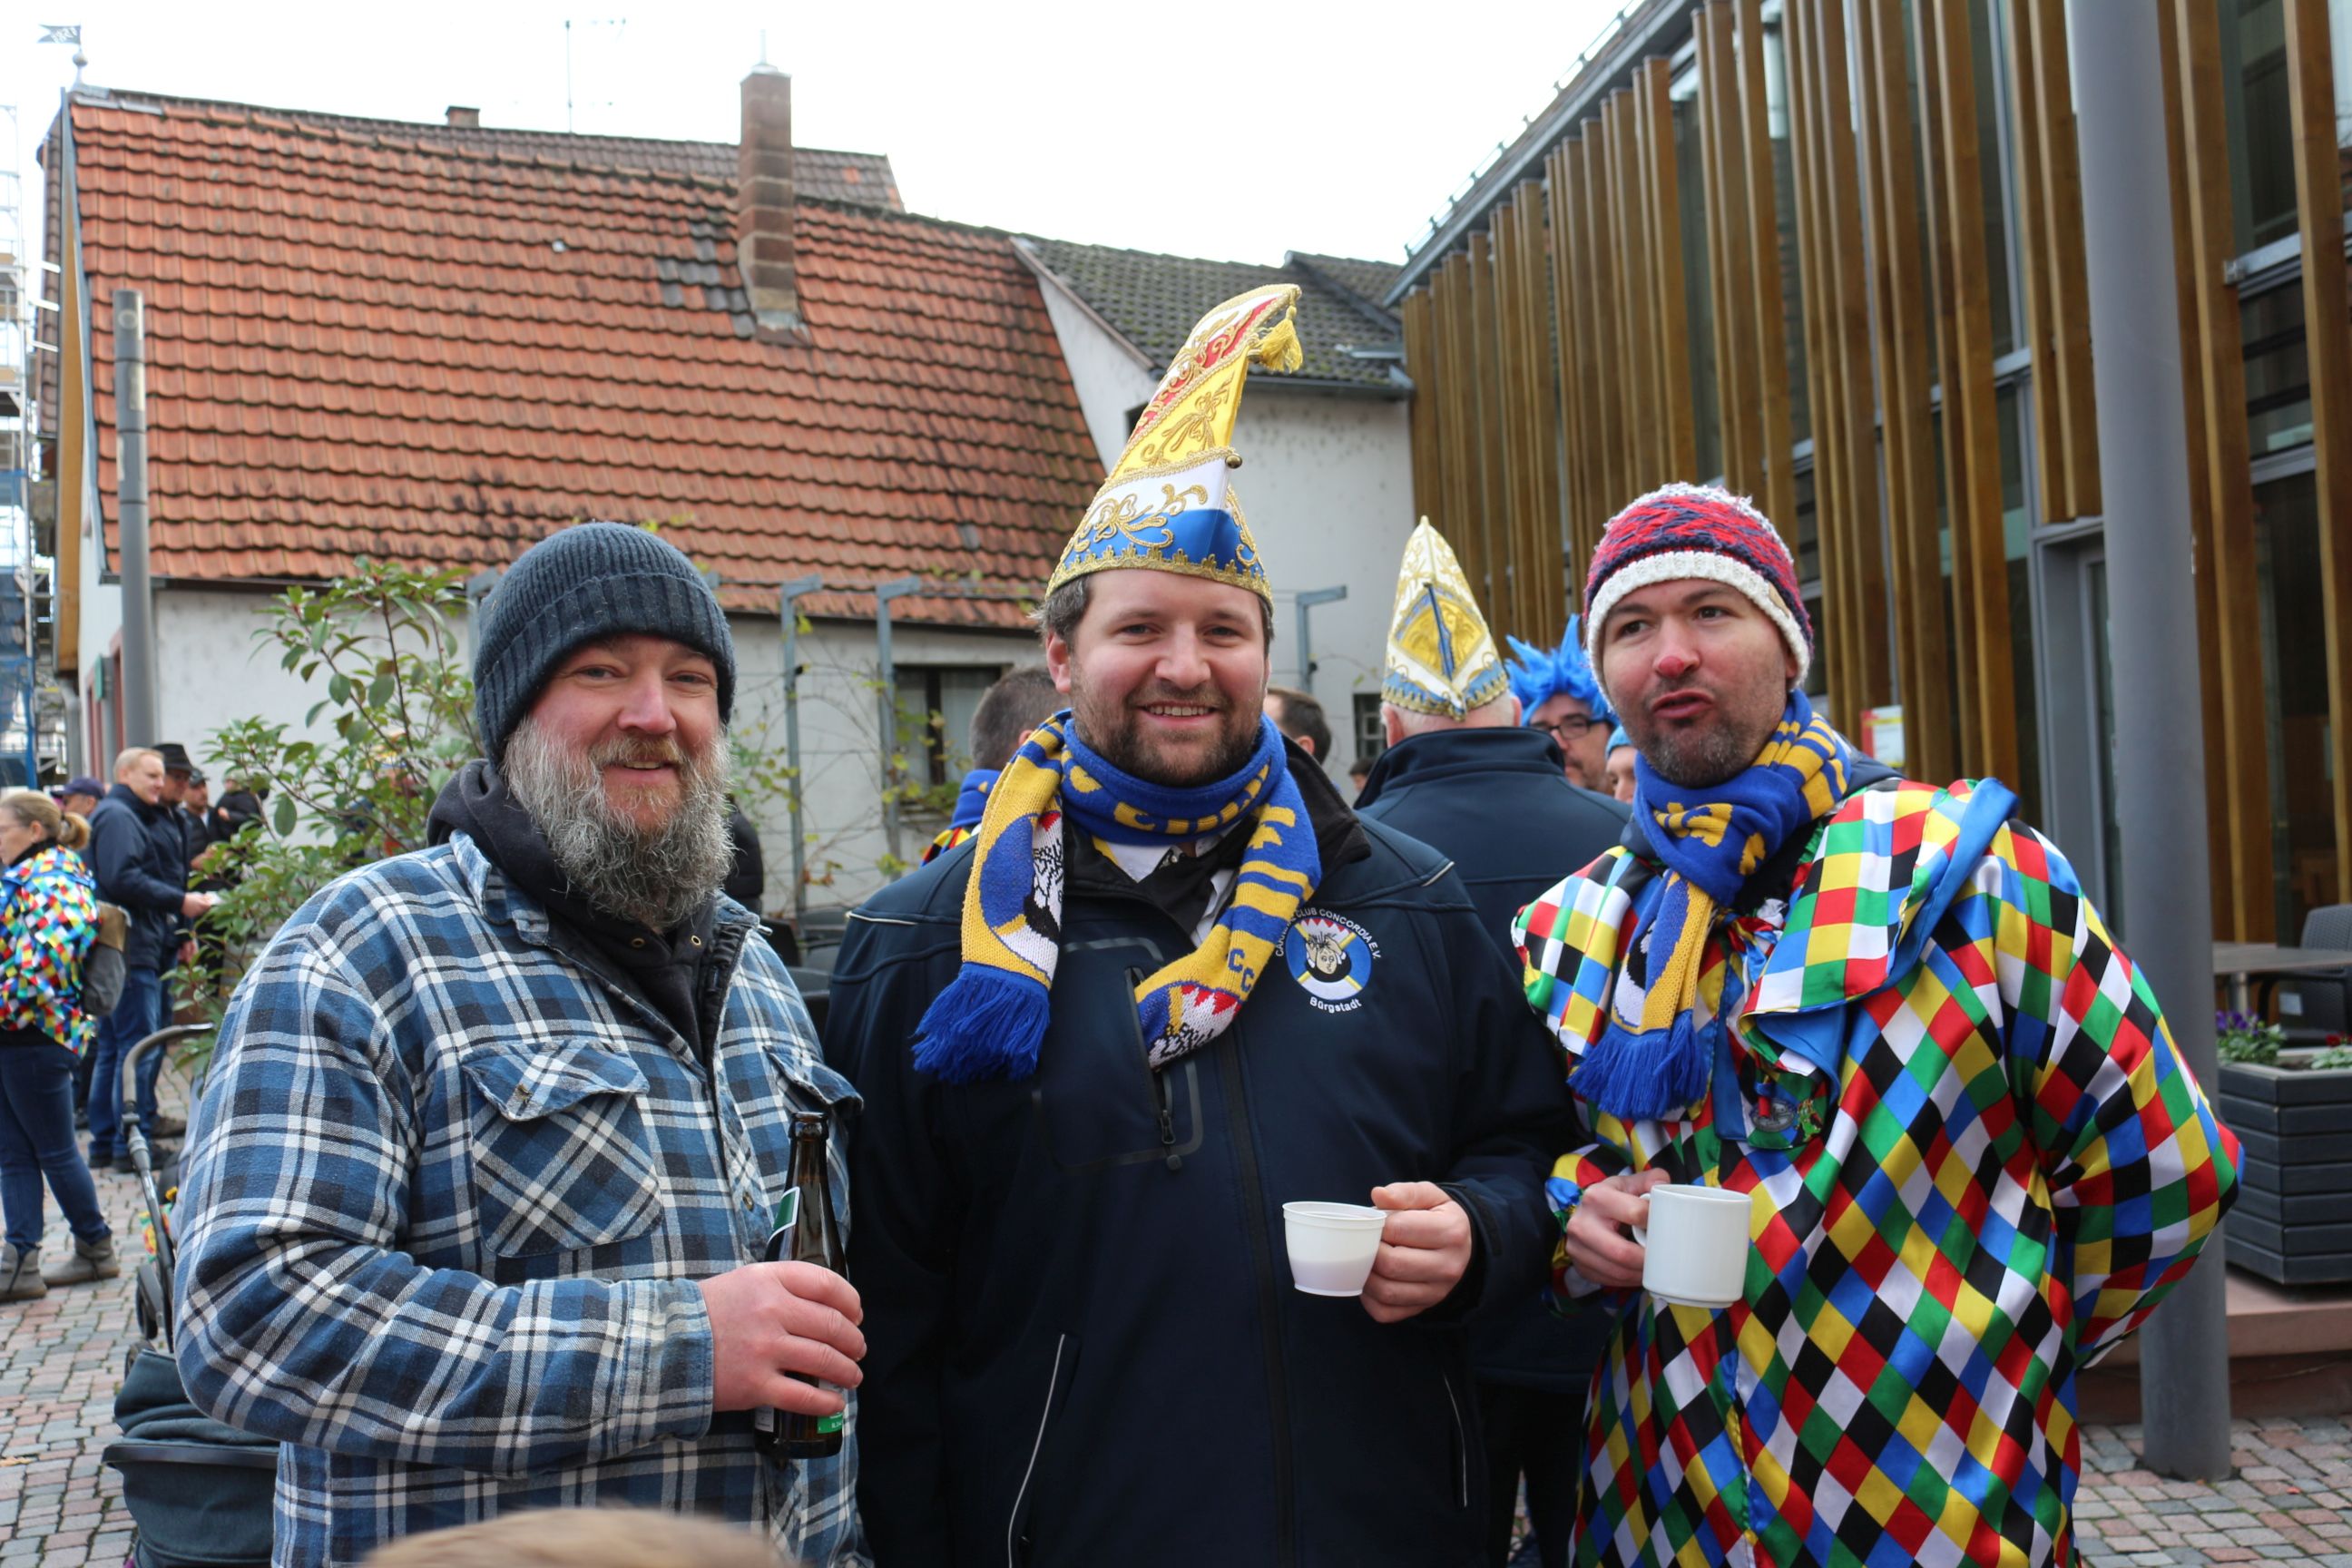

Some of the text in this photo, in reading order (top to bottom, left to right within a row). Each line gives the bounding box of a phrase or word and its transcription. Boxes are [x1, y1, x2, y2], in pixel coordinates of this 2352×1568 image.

[1296, 907, 1318, 918] CLUB
[1319, 908, 1372, 943] CONCORDIA
[1309, 996, 1362, 1014] Bürgstadt
